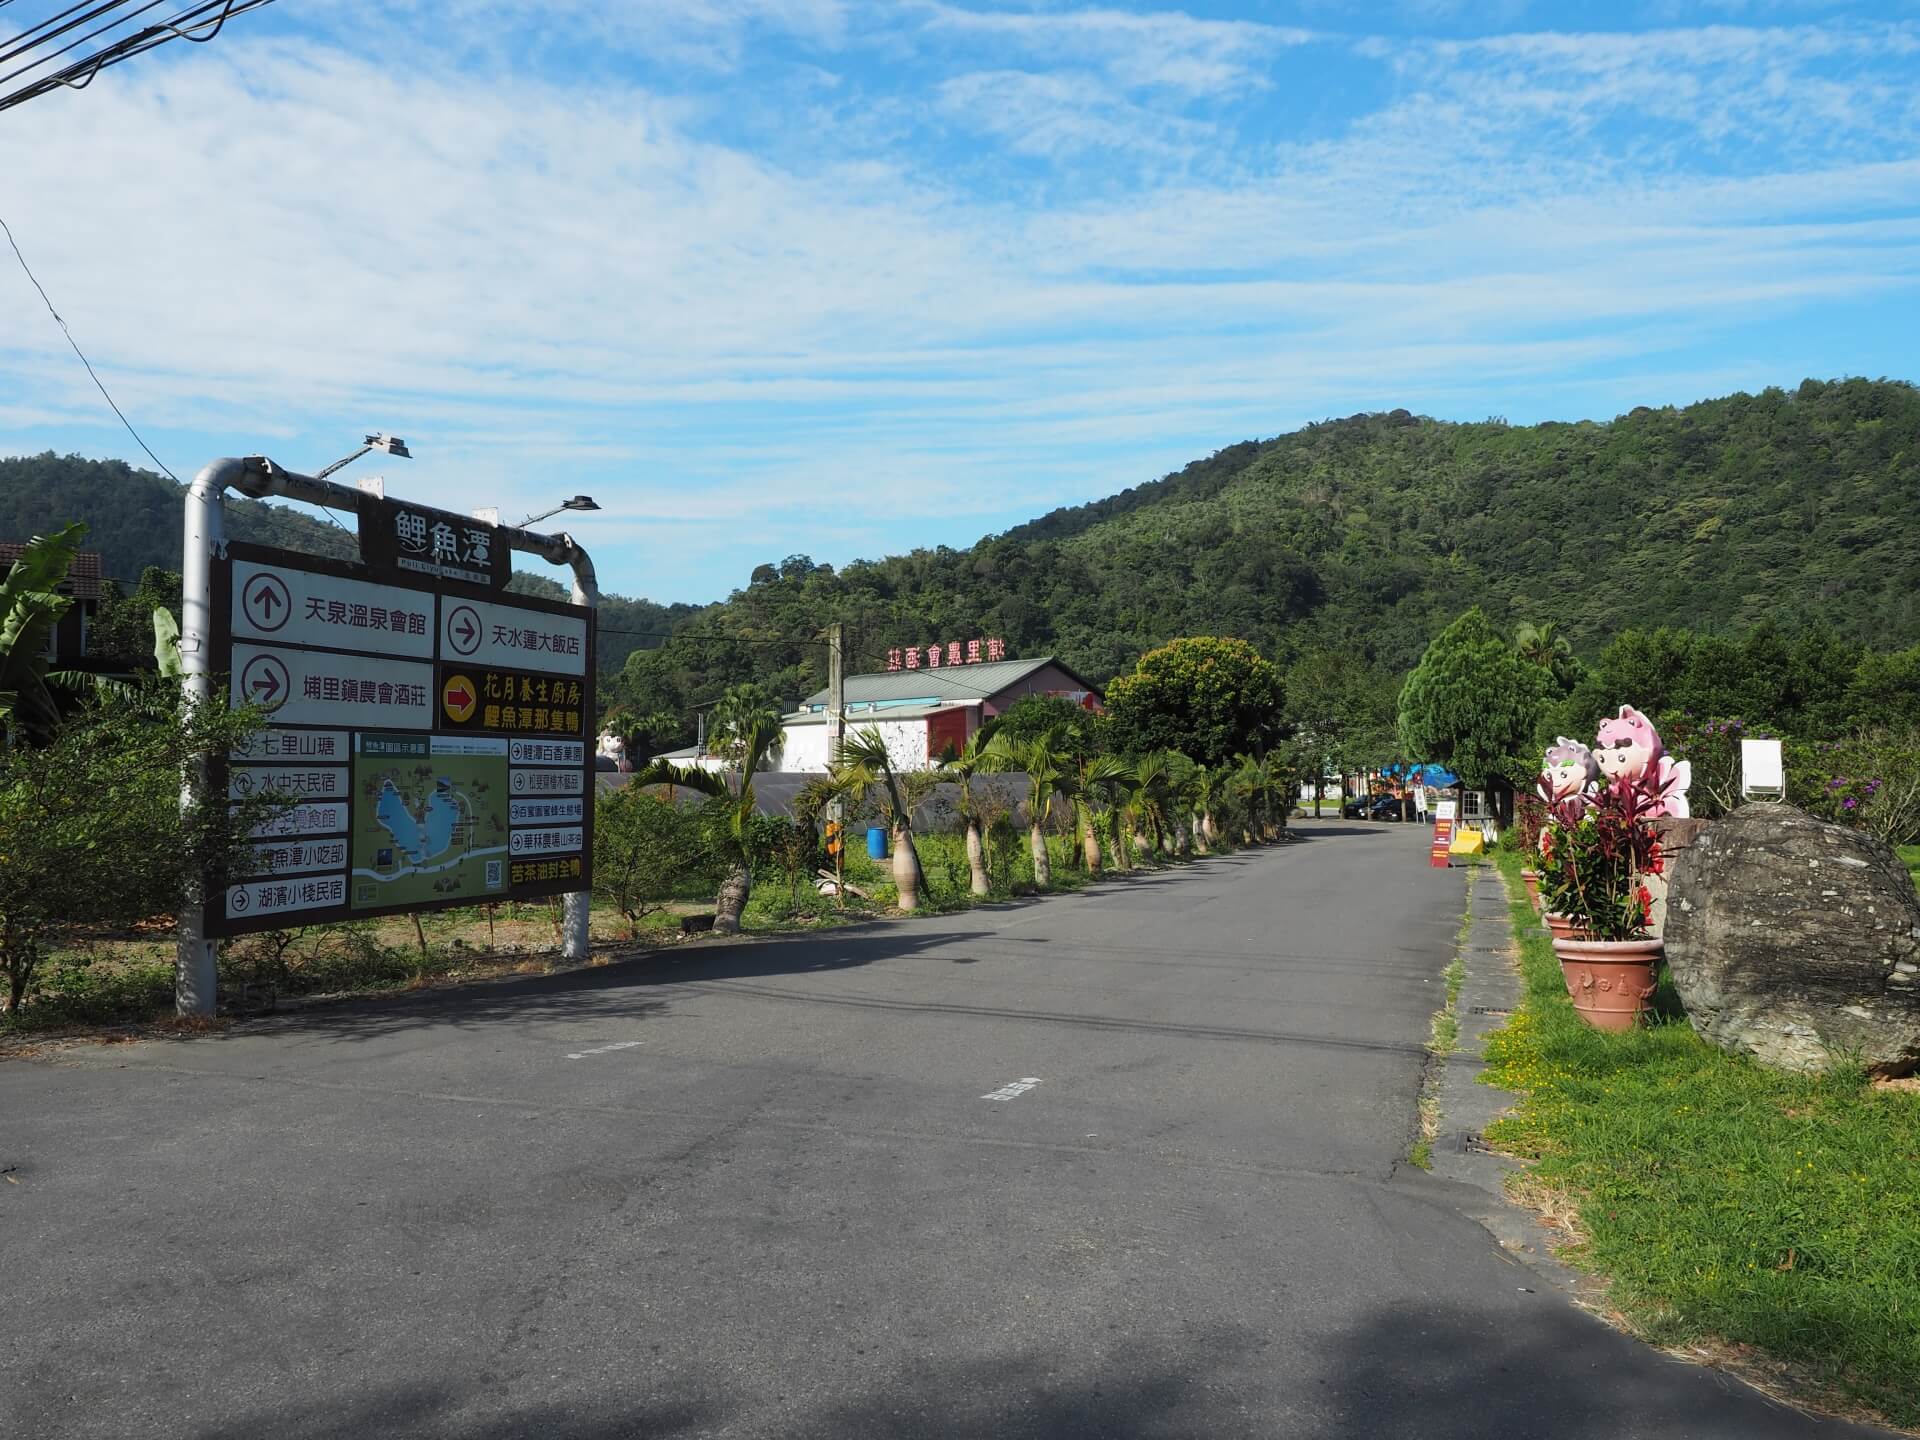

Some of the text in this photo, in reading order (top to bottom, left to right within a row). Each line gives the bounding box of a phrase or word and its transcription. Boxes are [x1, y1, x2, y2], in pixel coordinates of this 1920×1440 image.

[395, 509, 492, 568] 鯉魚潭
[305, 597, 426, 635] 天泉溫泉會館
[492, 625, 579, 656] 天水蓮大飯店
[484, 673, 581, 705] 花月養生廚房
[484, 704, 579, 732] 鯉魚潭那隻鴨
[261, 772, 336, 793] 水中天民宿
[258, 881, 343, 908] 湖濱小棧民宿
